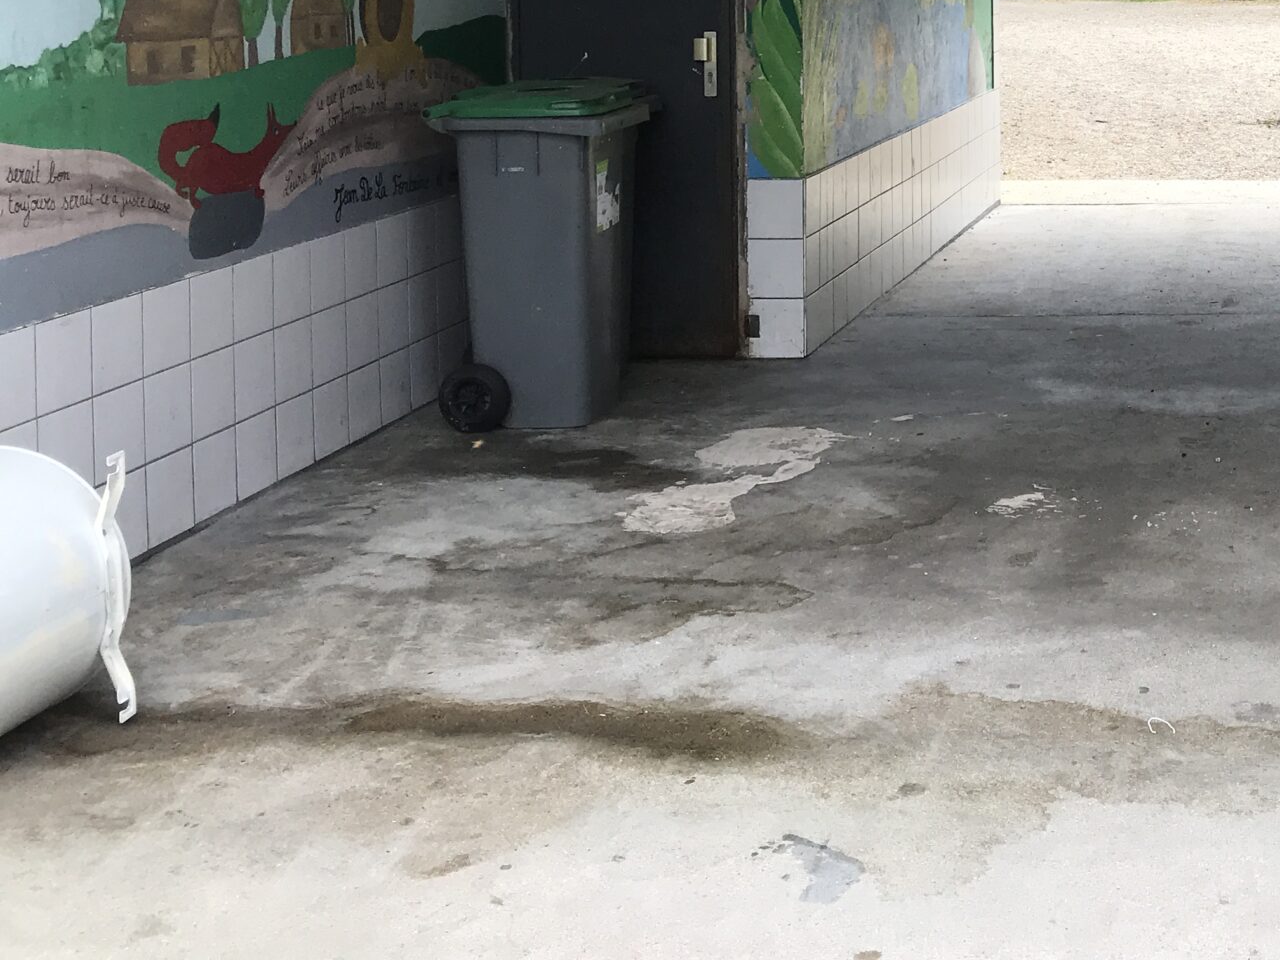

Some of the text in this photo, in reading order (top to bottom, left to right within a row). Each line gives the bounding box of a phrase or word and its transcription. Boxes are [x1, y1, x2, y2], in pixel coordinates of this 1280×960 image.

[6, 159, 71, 184] serait bon
[8, 193, 56, 228] toujours
[332, 183, 359, 223] Jean
[359, 176, 377, 202] De
[375, 171, 388, 199] La
